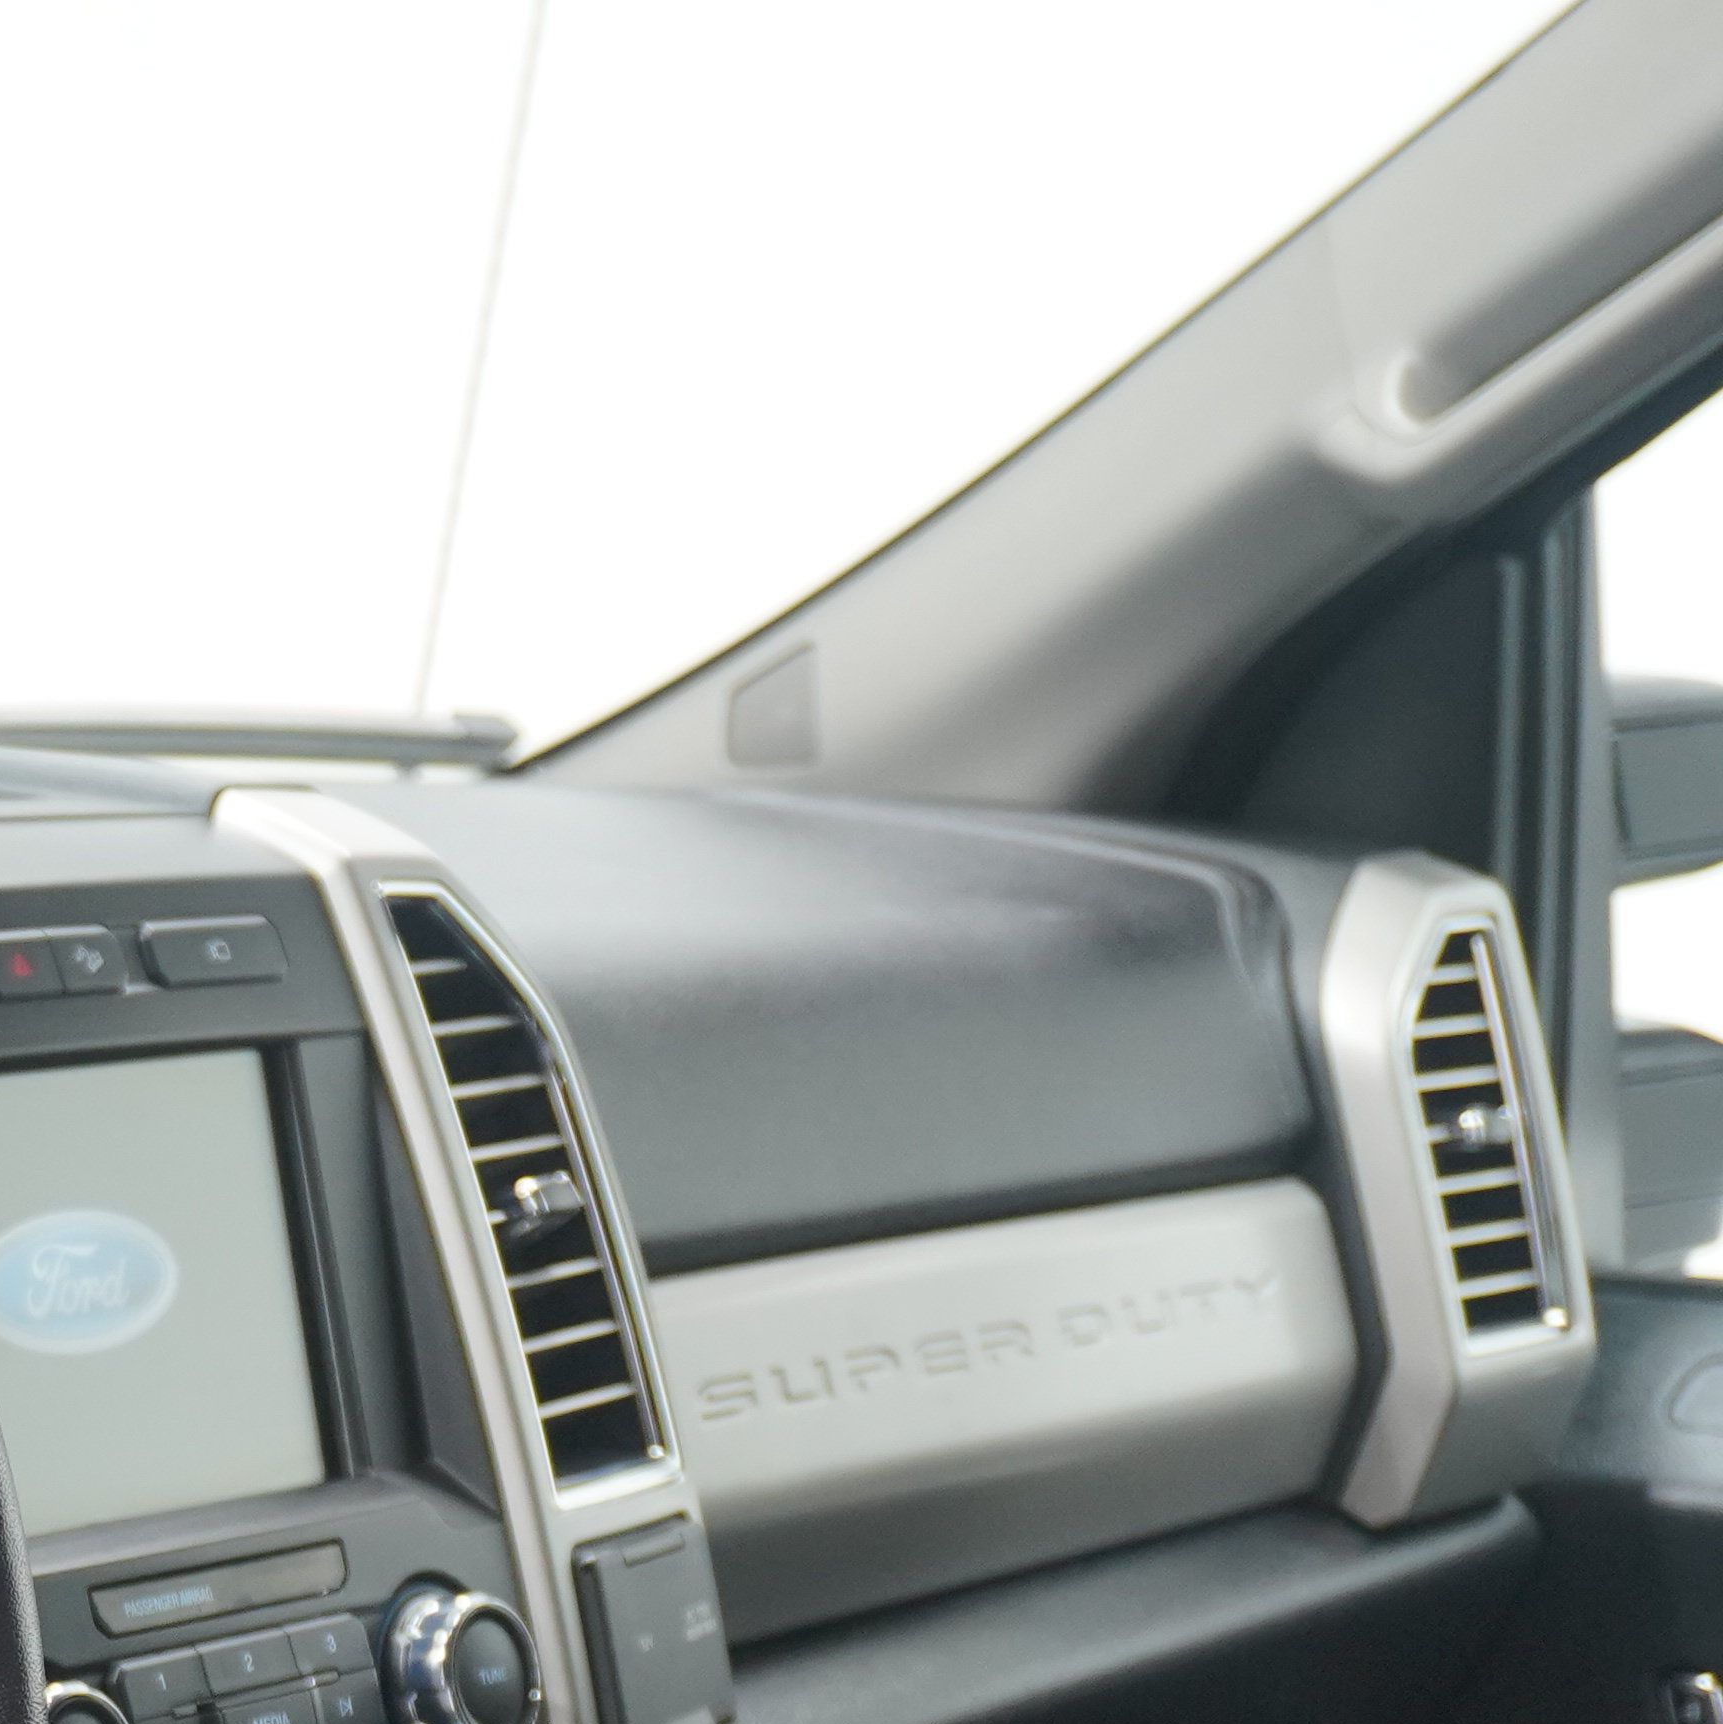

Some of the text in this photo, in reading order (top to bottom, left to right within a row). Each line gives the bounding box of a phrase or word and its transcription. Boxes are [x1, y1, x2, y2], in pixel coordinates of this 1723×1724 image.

[27, 1243, 130, 1319] Ford
[697, 1272, 1278, 1421] SUPER DUTY
[326, 1633, 337, 1652] 3
[244, 1653, 254, 1672] 2
[158, 1674, 167, 1691] 1
